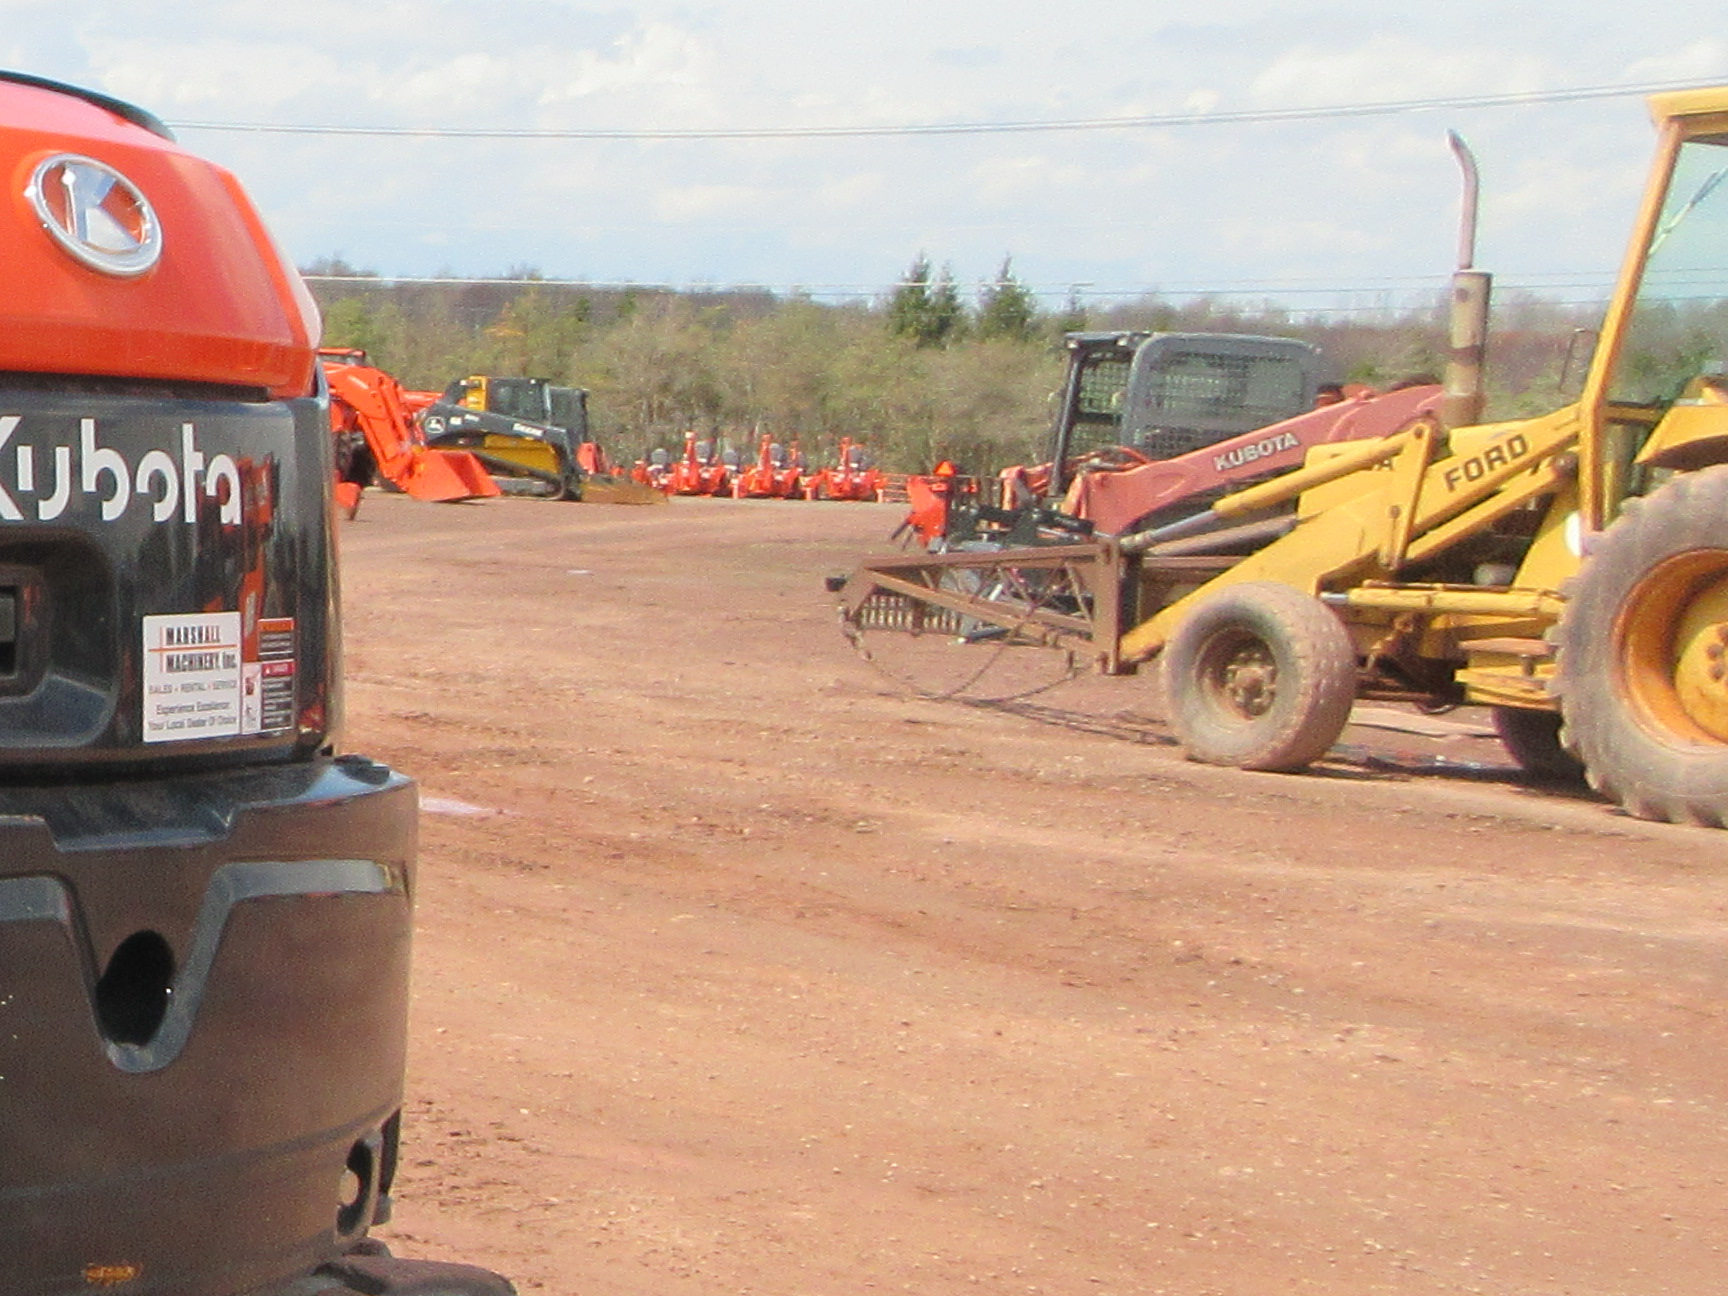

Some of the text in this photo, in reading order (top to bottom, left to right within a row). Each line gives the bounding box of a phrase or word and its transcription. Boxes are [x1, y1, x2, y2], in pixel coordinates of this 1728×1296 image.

[1213, 432, 1300, 471] KUBOTA
[1443, 434, 1529, 492] FORD
[166, 625, 221, 646] MARSHALL
